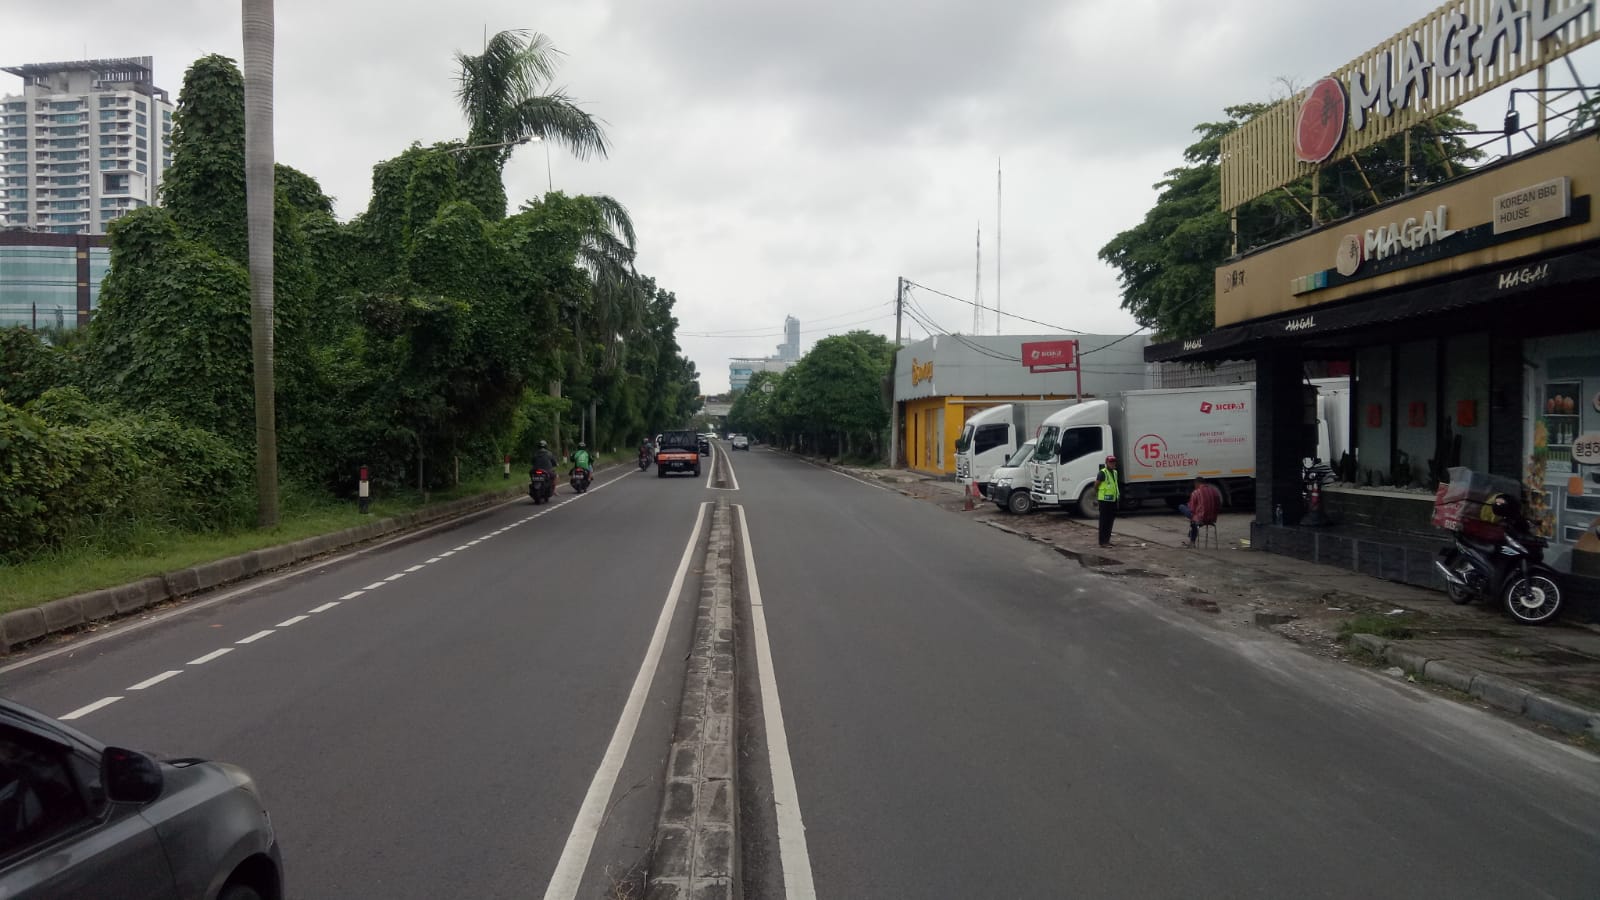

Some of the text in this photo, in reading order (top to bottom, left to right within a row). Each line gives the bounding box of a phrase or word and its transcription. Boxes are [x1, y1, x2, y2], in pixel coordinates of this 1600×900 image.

[1351, 0, 1593, 131] MAGAL
[1500, 185, 1558, 209] KOREAN BBQ
[1500, 207, 1530, 223] HOUSE
[1364, 205, 1459, 261] MAGAL
[1498, 263, 1550, 291] MAGAL
[1140, 443, 1161, 459] 15
[1155, 458, 1199, 468] DELIVERY
